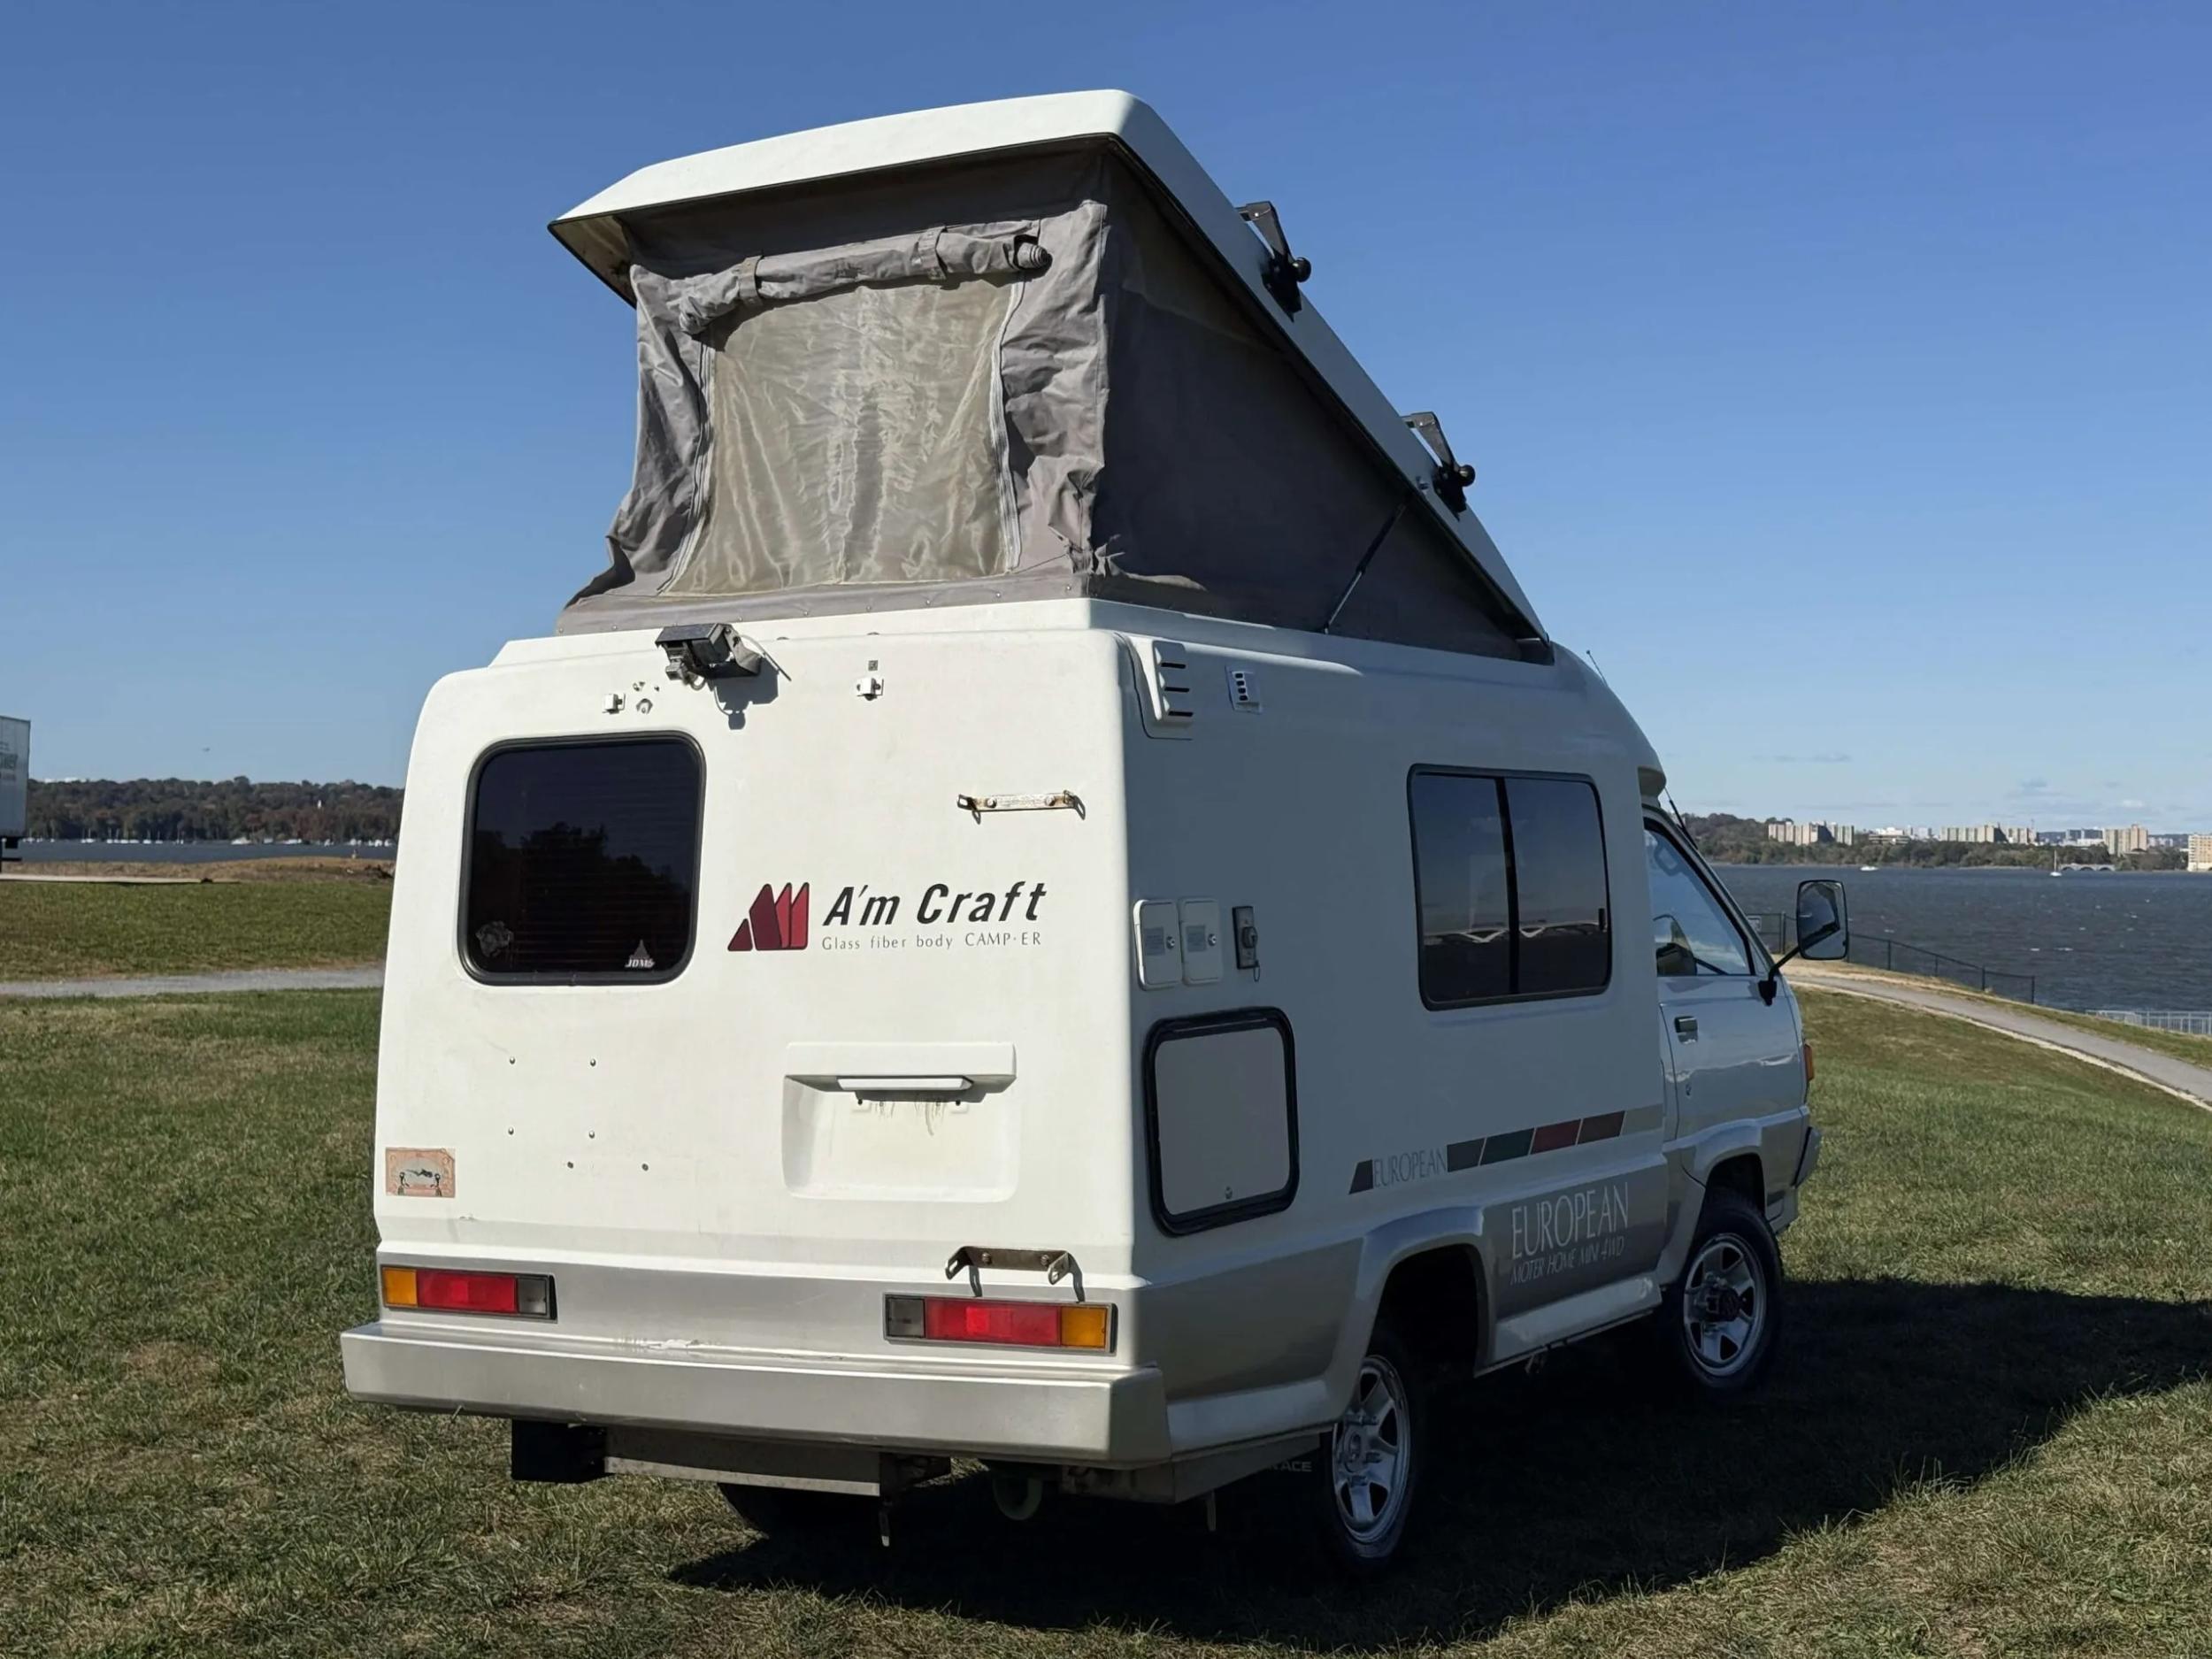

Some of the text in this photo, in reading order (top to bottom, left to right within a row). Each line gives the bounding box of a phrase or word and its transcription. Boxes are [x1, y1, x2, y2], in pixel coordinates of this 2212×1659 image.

[822, 880, 1048, 926] A'm Craft
[822, 937, 861, 950] Glass
[870, 934, 907, 949] fiber
[916, 933, 954, 950] body
[1373, 1148, 1447, 1187] EUROPEAN
[1511, 1182, 1629, 1260] EUROPEAN
[1547, 1248, 1577, 1275] HOME
